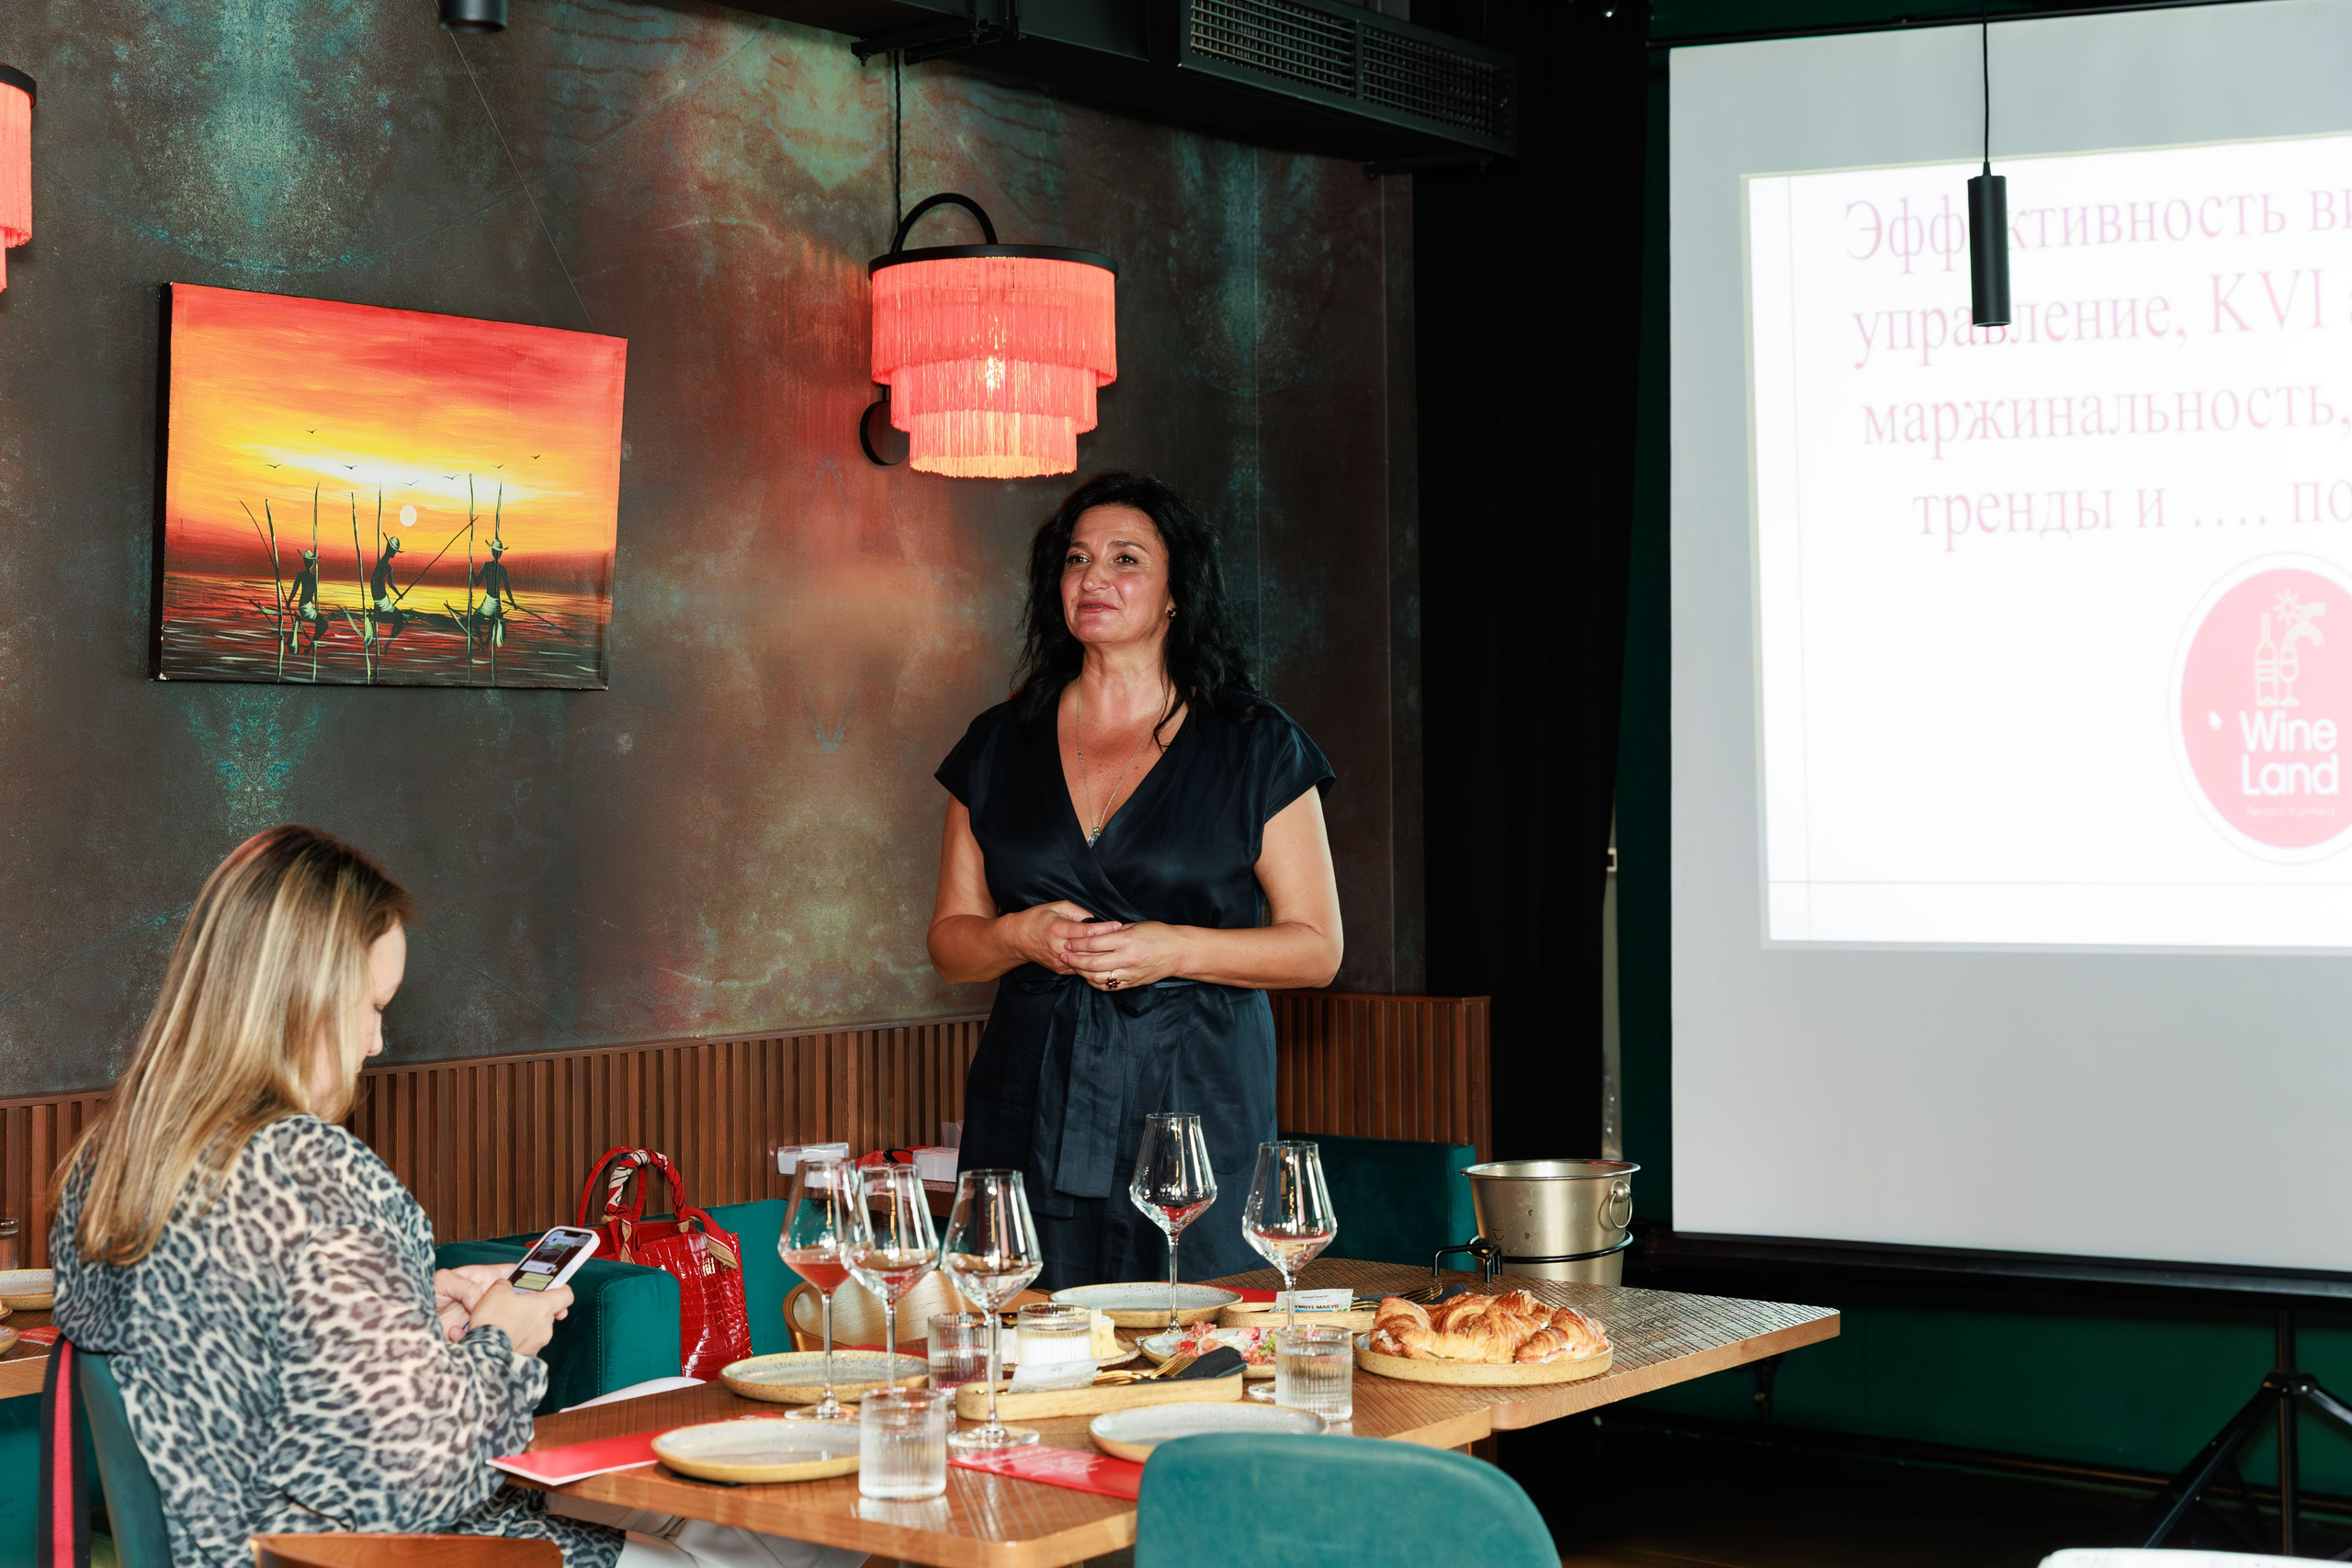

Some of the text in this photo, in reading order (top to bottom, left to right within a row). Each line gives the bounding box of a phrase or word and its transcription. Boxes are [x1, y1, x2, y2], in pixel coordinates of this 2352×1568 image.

[1846, 192, 2289, 276] Эффктивность
[2209, 267, 2325, 335] KVI
[1862, 383, 2352, 461] маржинальность,
[1913, 488, 2114, 553] тренды
[2135, 488, 2167, 529] и
[2239, 710, 2338, 751] Wine
[2242, 753, 2339, 795] Land
